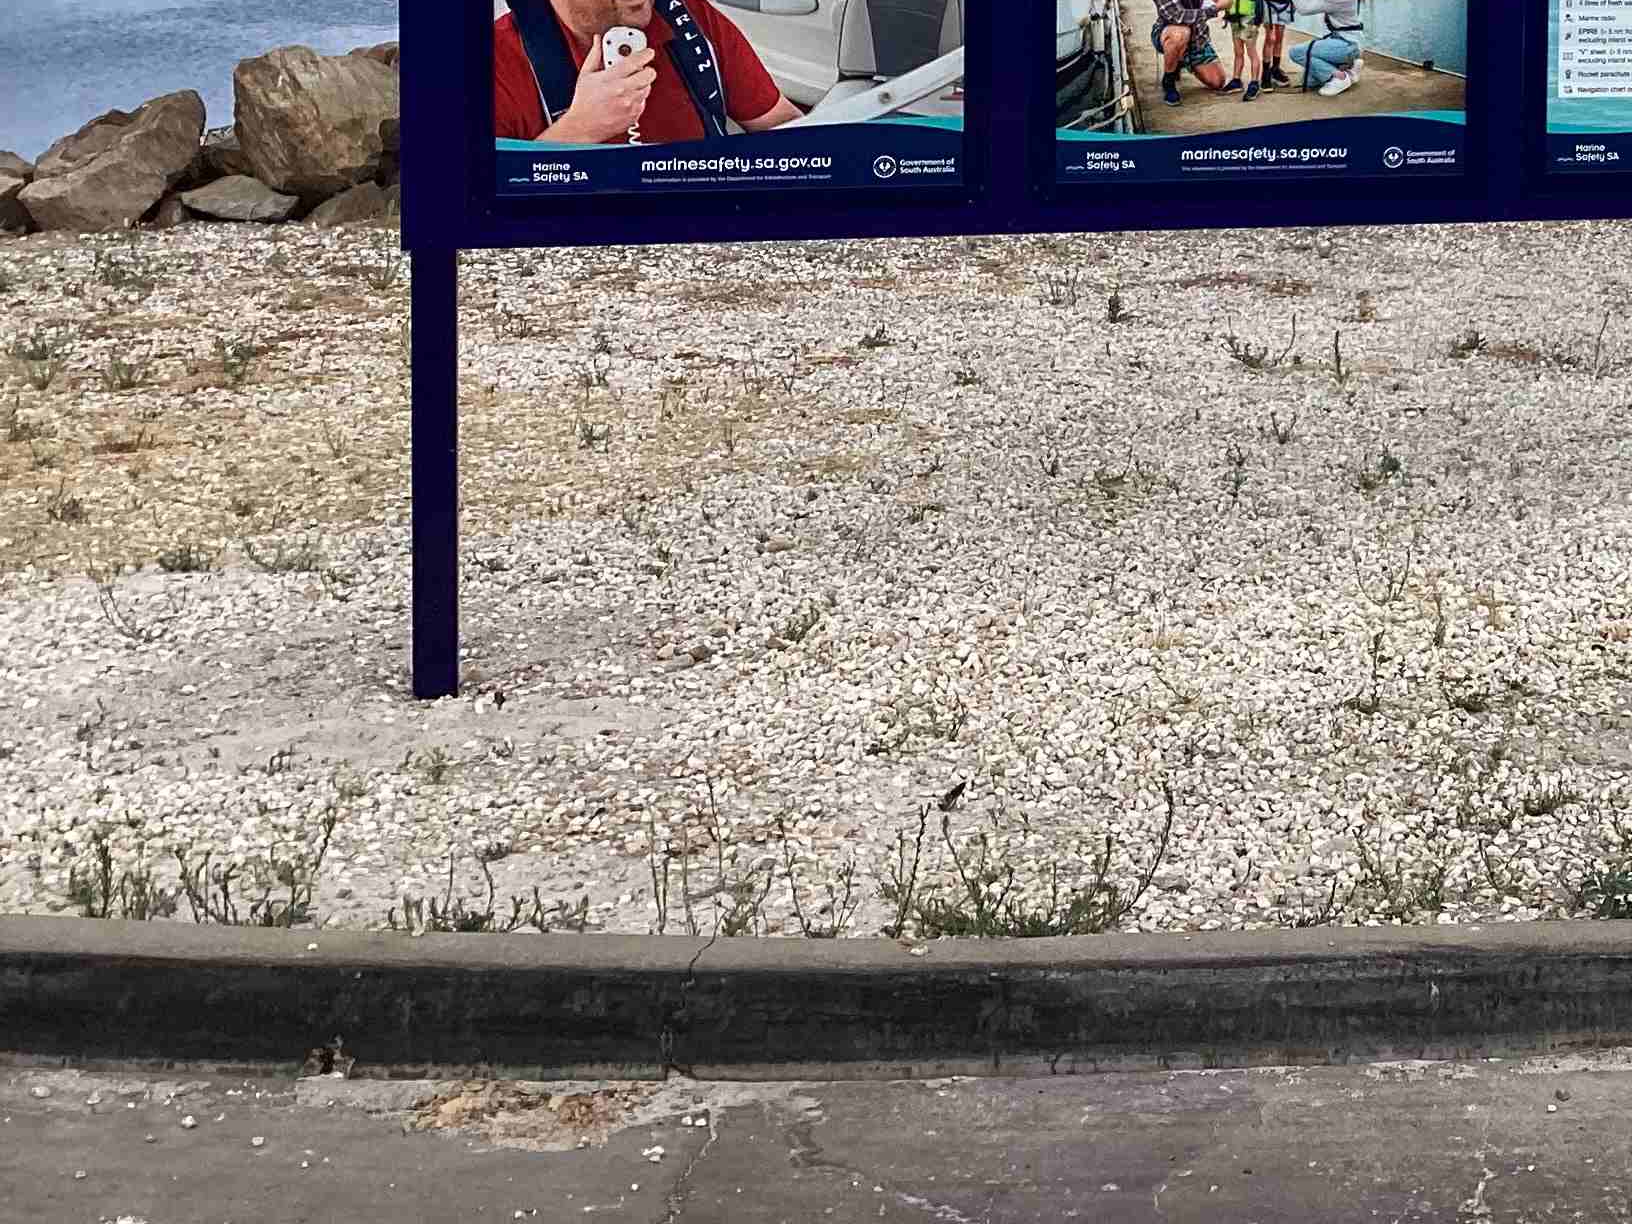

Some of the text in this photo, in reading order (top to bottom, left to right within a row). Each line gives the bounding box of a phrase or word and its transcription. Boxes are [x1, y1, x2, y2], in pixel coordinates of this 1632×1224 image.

[1086, 151, 1119, 159] Marine
[1181, 147, 1347, 161] marinesafety.sa.gov.au
[1575, 151, 1619, 161] Safety SA
[532, 162, 570, 171] Marine
[641, 156, 831, 172] marinesafety.sa.gov.au
[1086, 160, 1135, 171] Safety SA
[533, 171, 588, 182] Safety SA
